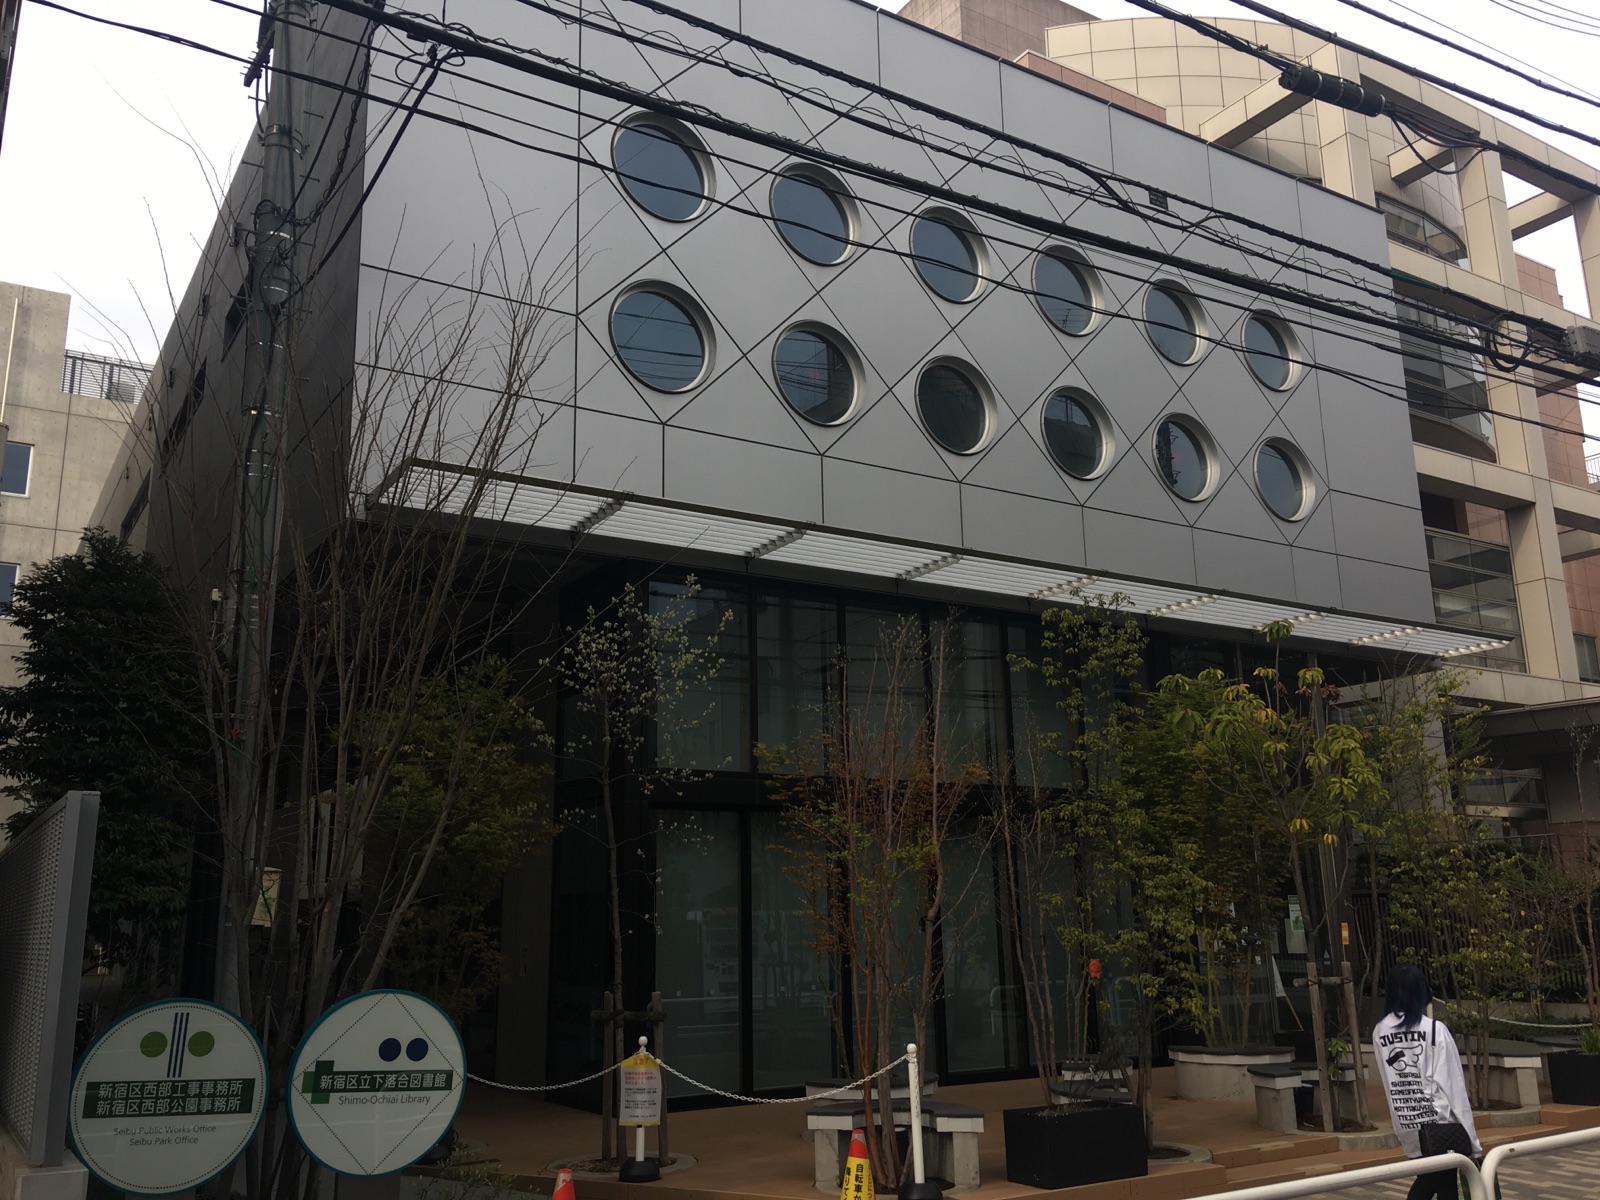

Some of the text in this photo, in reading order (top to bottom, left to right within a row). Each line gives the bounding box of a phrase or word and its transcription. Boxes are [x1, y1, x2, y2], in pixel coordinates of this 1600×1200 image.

[1379, 1031, 1426, 1047] JUSTIN
[98, 1080, 244, 1099] 新宿区西部工事事務所
[320, 1073, 447, 1090] 新宿区立下落合図書館
[96, 1096, 242, 1116] 新宿区西部公園事務所
[338, 1094, 431, 1106] Shimo-Ochiai Library
[113, 1124, 217, 1136] Seibu Public Works Office
[129, 1135, 199, 1146] Seibu Park Office
